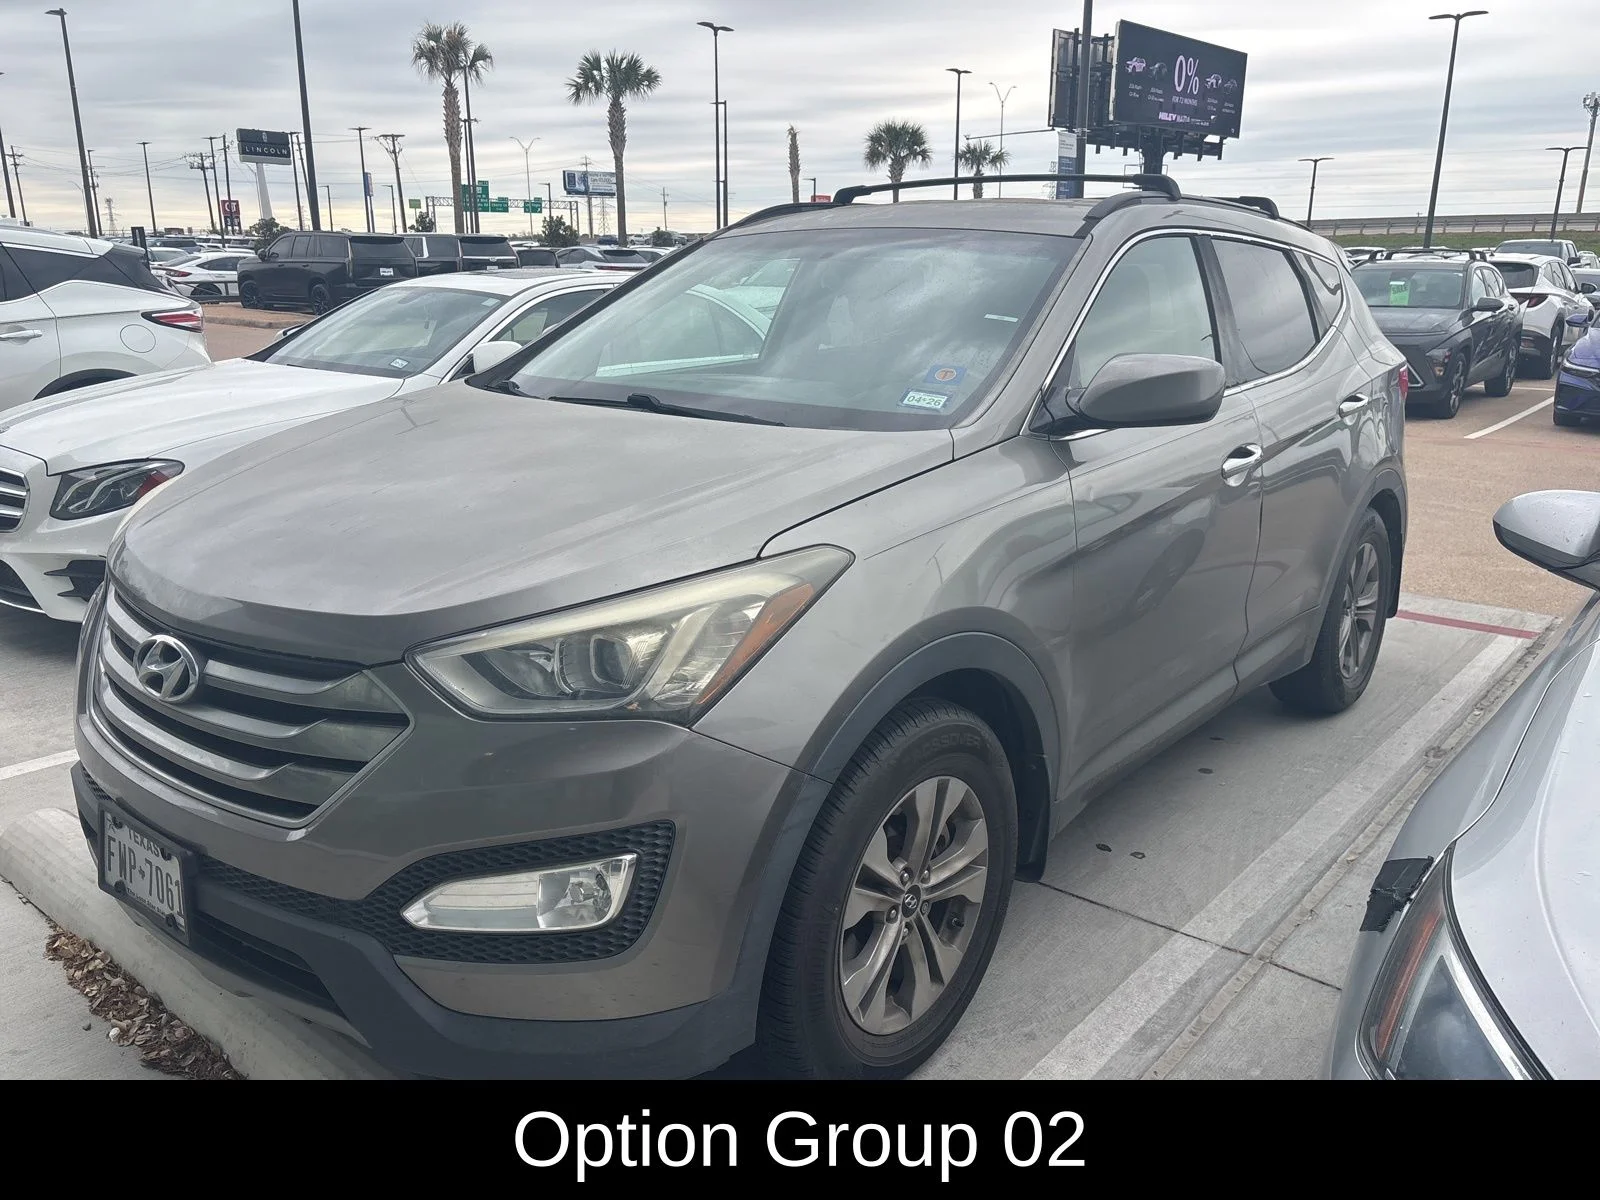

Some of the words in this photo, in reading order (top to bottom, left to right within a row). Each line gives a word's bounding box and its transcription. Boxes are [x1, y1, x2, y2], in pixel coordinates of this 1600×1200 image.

[1174, 55, 1199, 95] 0%
[245, 146, 288, 155] LINCOLN
[127, 828, 160, 858] TEXAS
